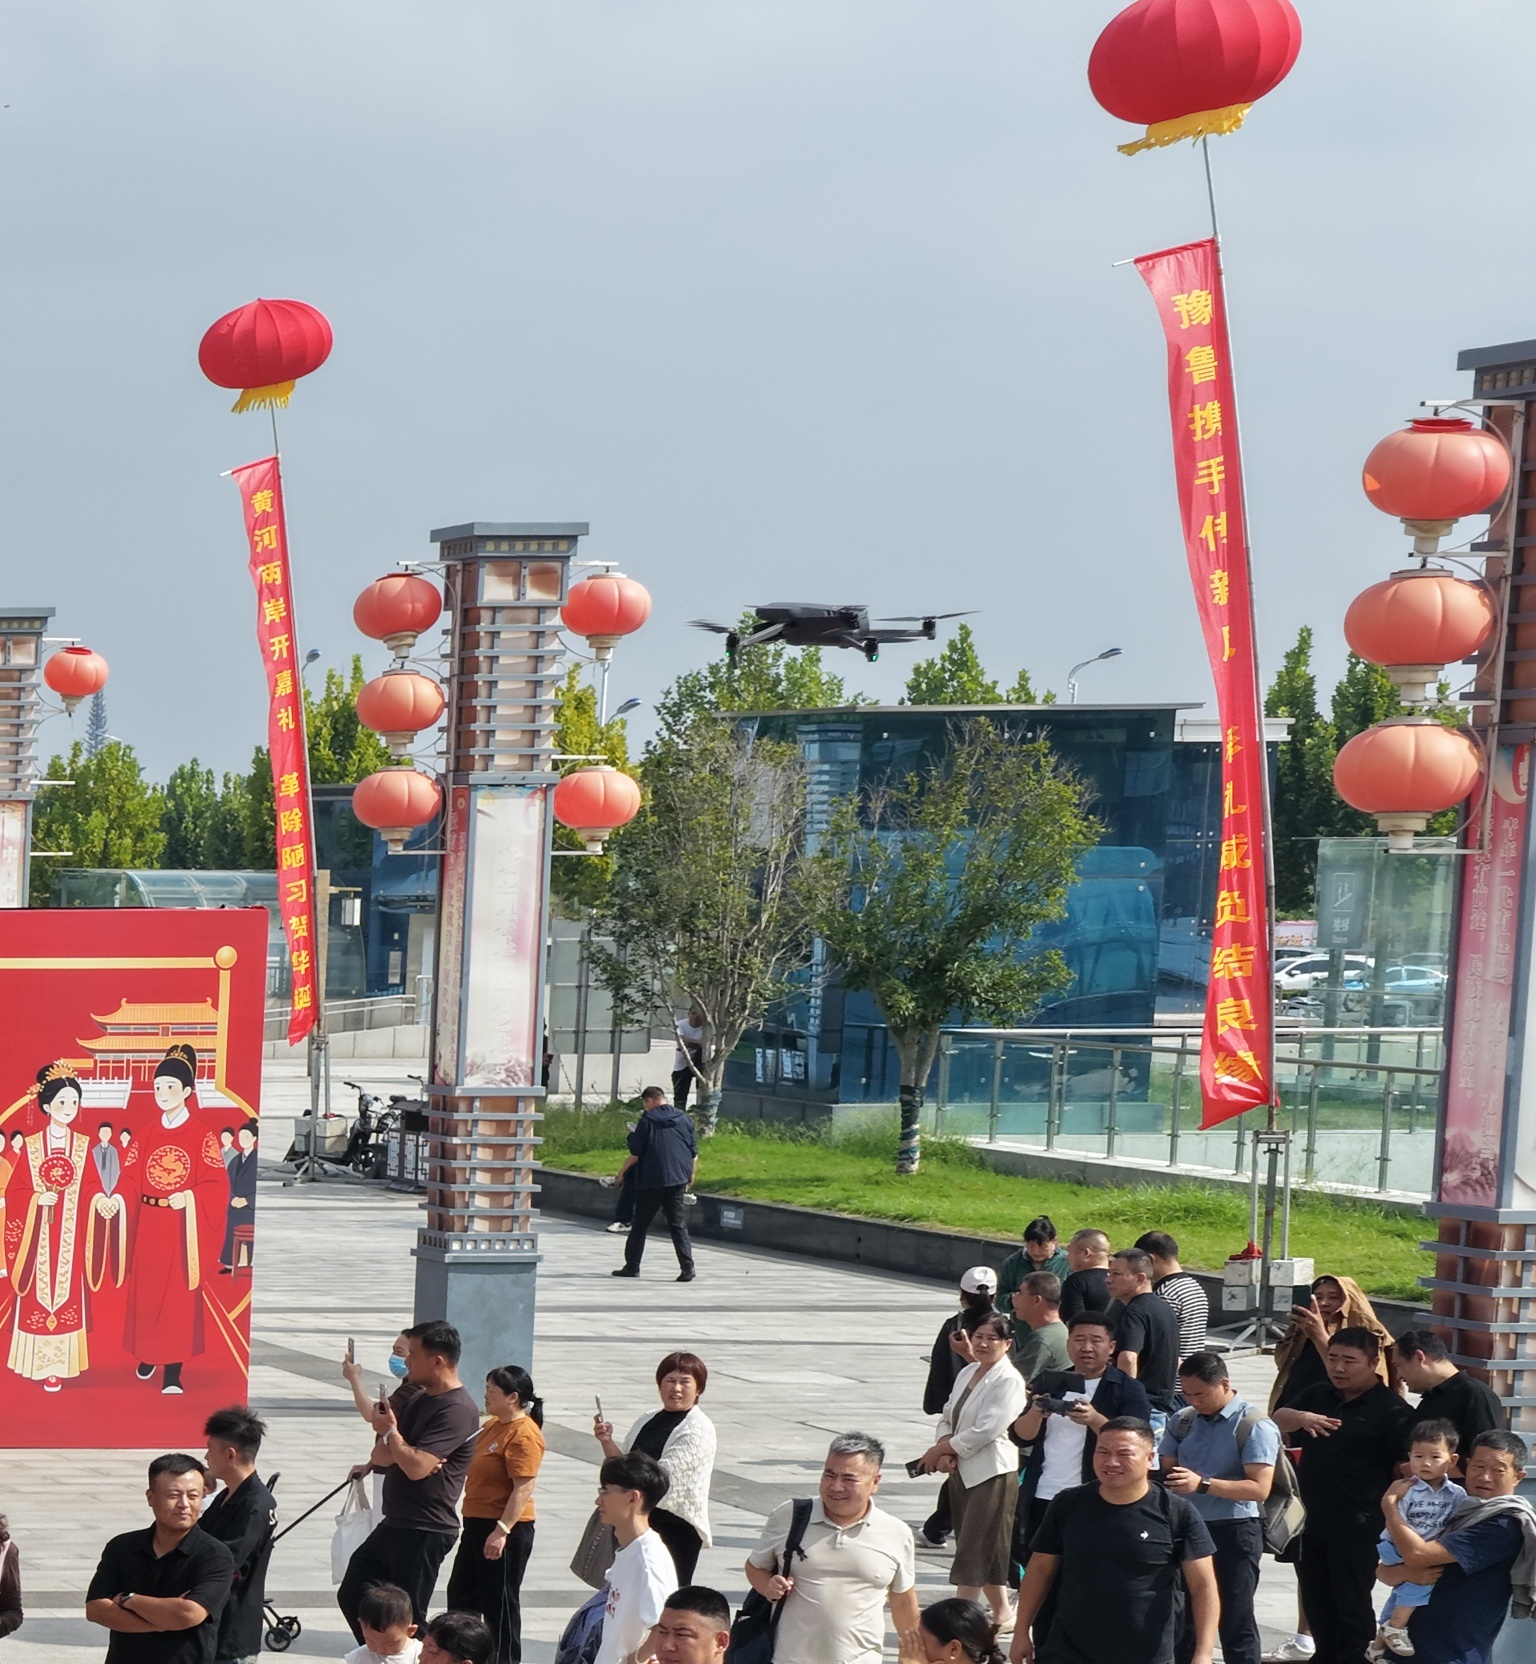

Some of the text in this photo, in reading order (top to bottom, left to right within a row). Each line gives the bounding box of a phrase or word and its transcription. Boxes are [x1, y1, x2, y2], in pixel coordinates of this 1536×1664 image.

[250, 488, 313, 1011] 黄河两岸开嘉礼 革除陋习贺华诞
